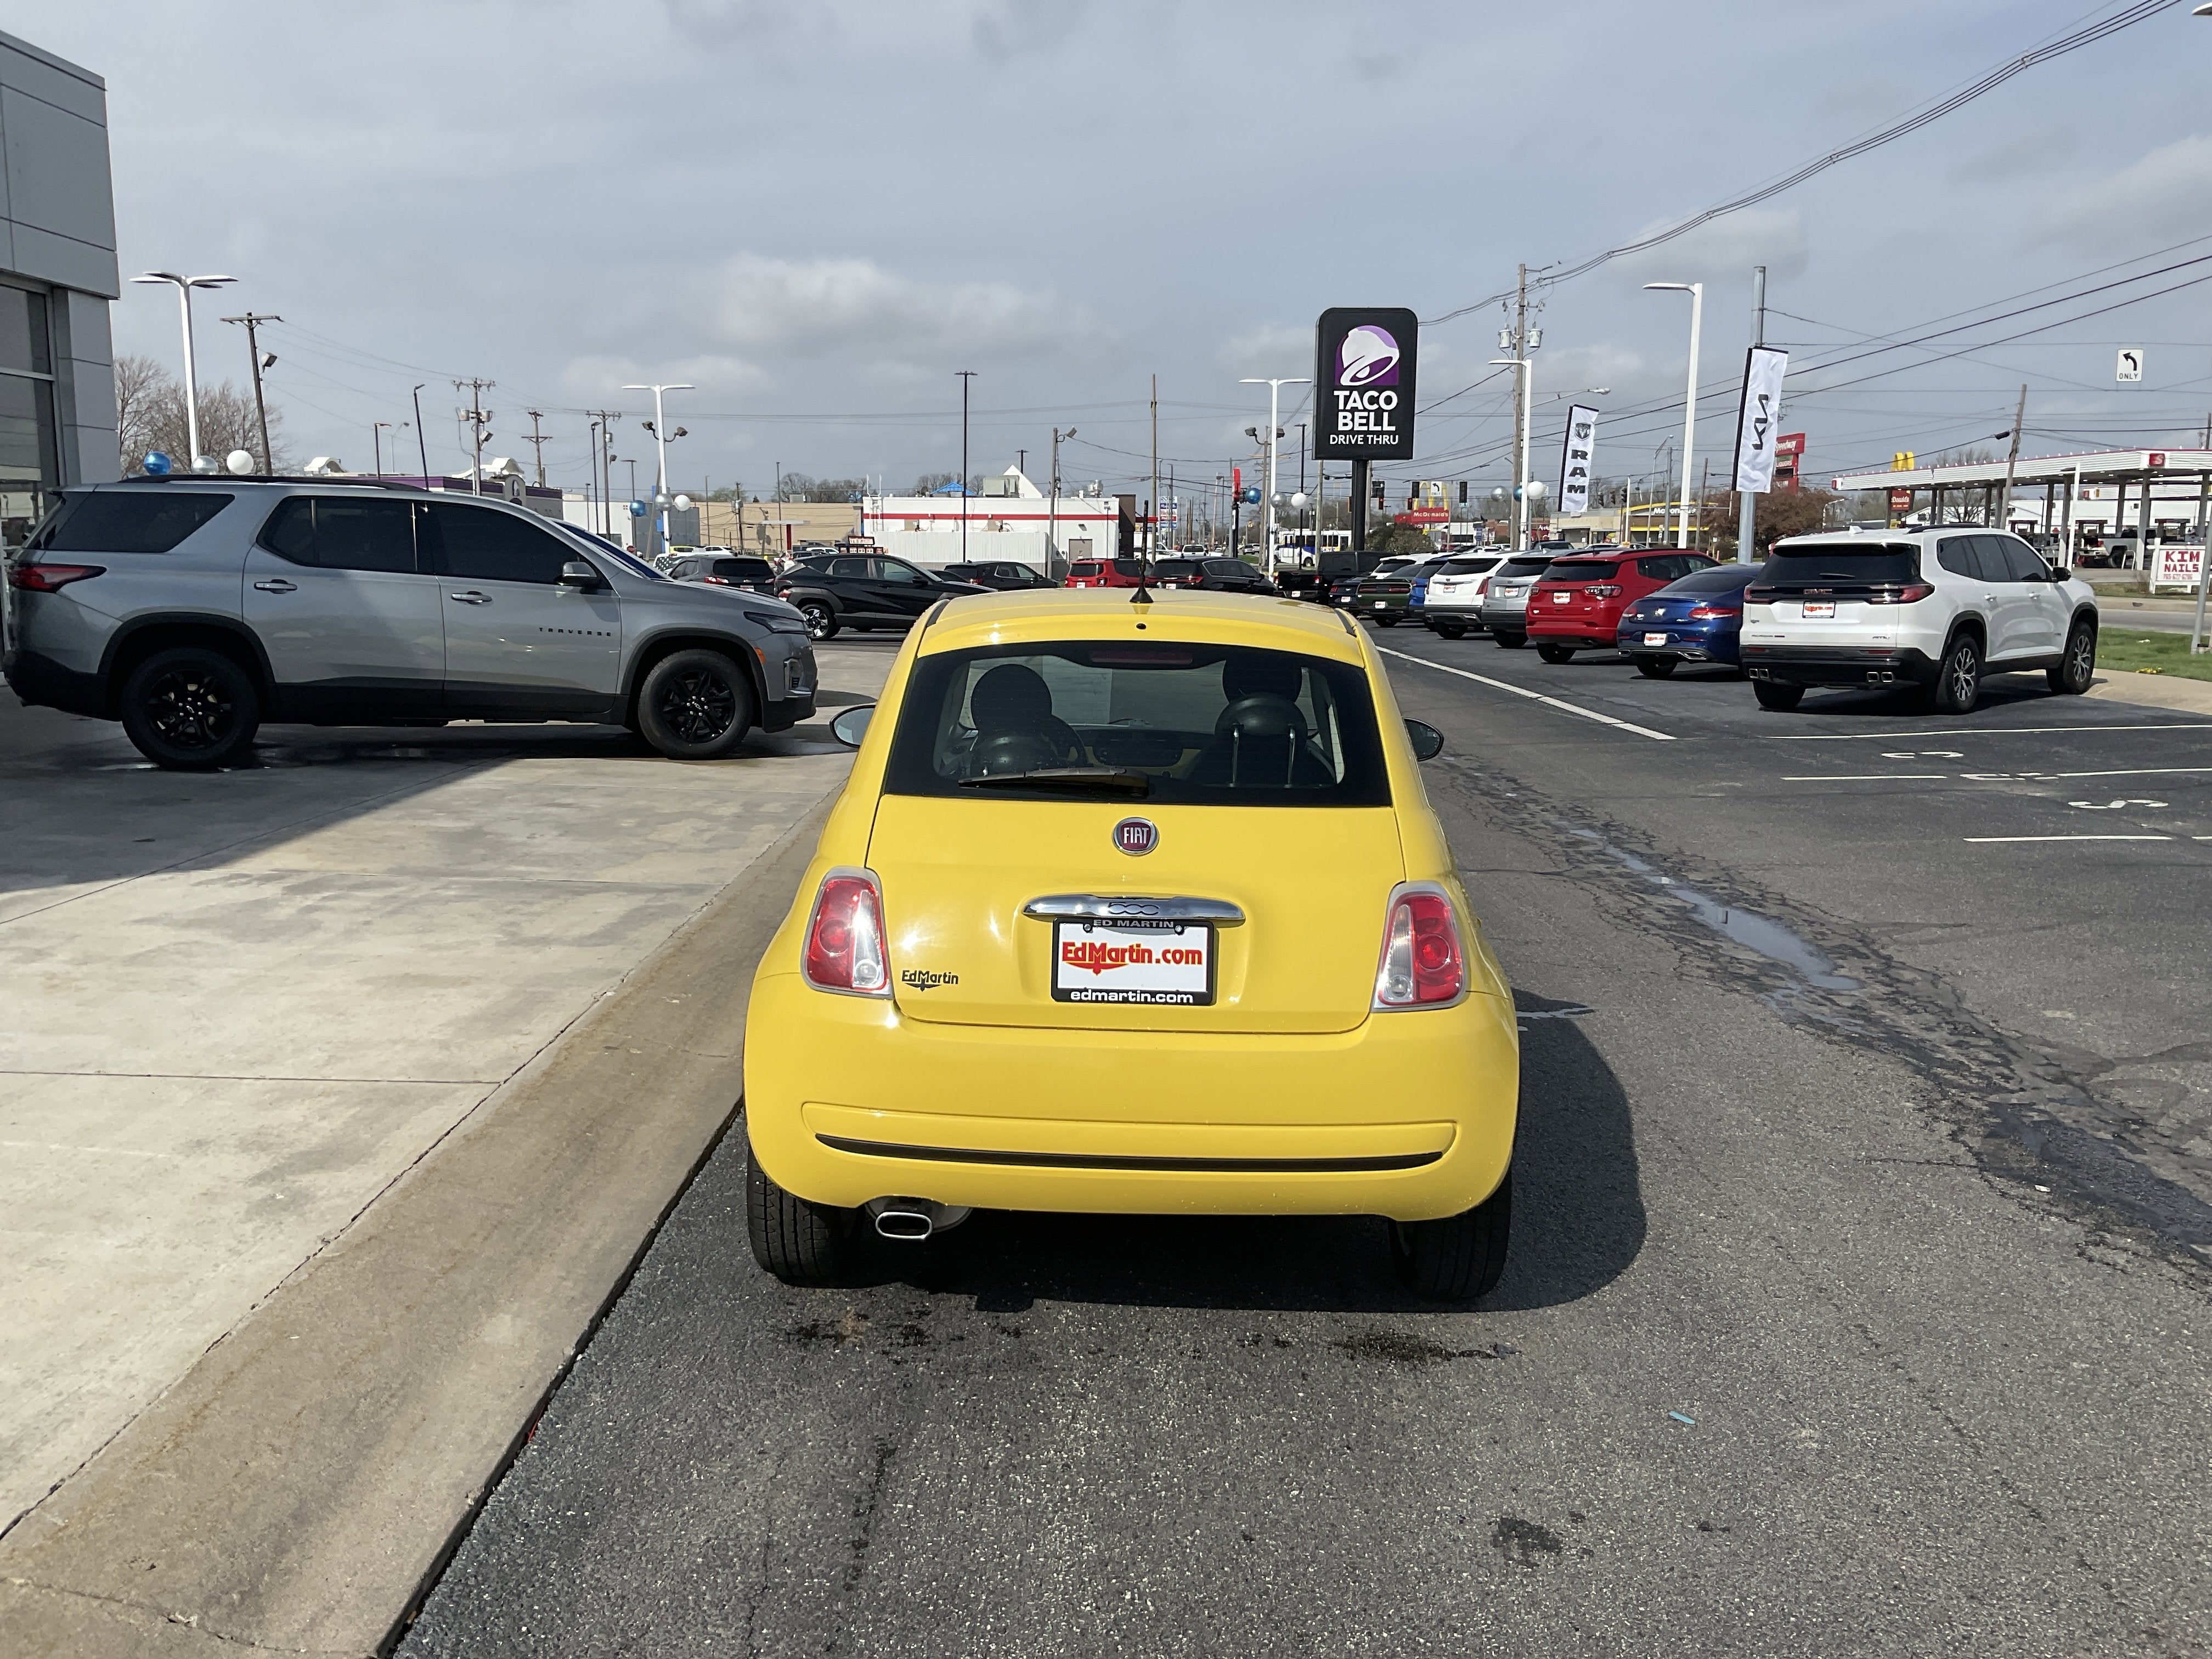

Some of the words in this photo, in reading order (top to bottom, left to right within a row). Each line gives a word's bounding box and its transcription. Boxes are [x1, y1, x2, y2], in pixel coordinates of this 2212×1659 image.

[1334, 390, 1398, 410] TACO
[1338, 411, 1396, 431] BELL
[1330, 435, 1364, 445] DRIVE
[1367, 435, 1399, 445] THRU
[1567, 449, 1589, 494] RAM
[2165, 551, 2200, 562] KIM
[2164, 564, 2199, 572] NAILS
[539, 627, 612, 637] TRAVERSE
[1124, 827, 1149, 844] FIAT
[1108, 901, 1160, 916] 500
[1117, 919, 1175, 928] MARTIN
[1070, 989, 1194, 1003] edmartin.com
